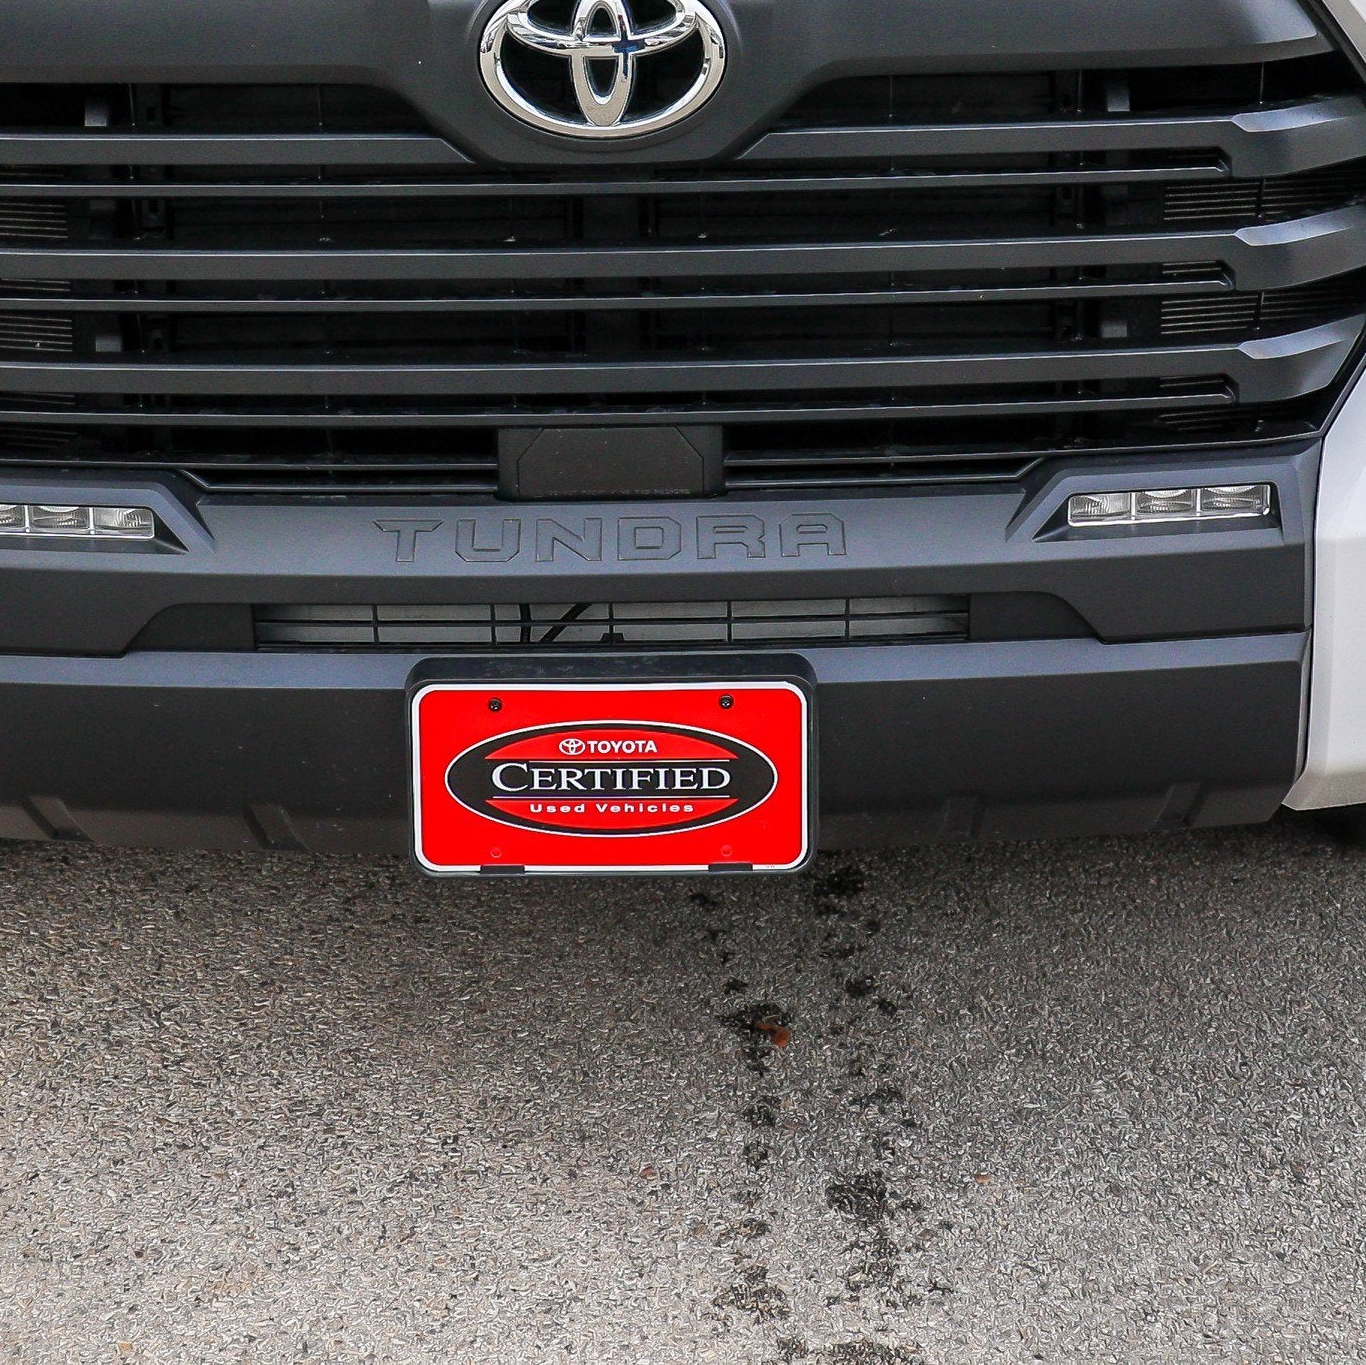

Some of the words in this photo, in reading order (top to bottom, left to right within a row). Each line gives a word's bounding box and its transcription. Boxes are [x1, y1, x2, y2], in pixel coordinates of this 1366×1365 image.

[372, 512, 847, 563] TUNDRA
[587, 739, 657, 754] TOYOTA
[491, 762, 732, 792] CERTIFIED
[530, 803, 586, 814] Used
[595, 802, 694, 814] Vehicles
